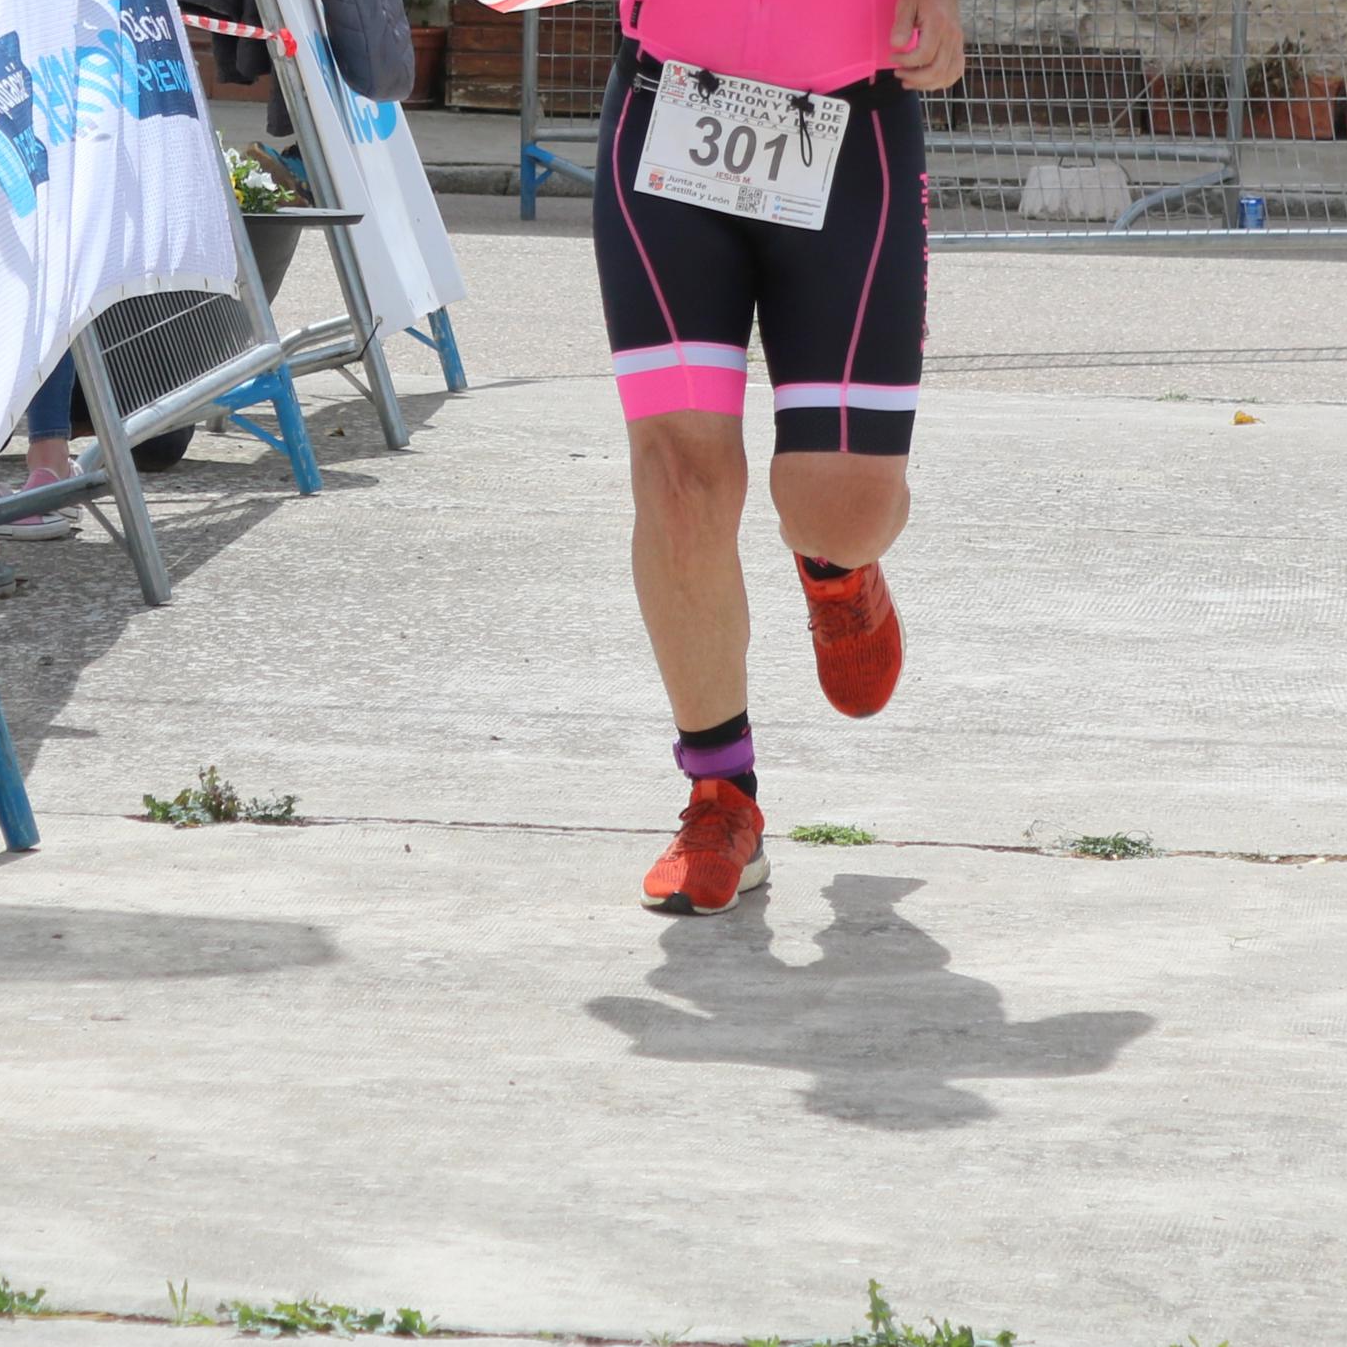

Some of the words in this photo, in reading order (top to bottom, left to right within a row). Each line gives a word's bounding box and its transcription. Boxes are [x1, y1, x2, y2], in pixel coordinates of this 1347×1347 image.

[688, 92, 770, 122] CASTILLA
[778, 115, 789, 125] Y
[772, 102, 783, 112] Y
[820, 112, 843, 124] DE
[823, 102, 845, 112] DE
[688, 116, 788, 182] 301
[666, 175, 693, 187] Junta
[695, 181, 707, 190] de
[665, 184, 697, 197] Castilla
[707, 194, 730, 205] León
